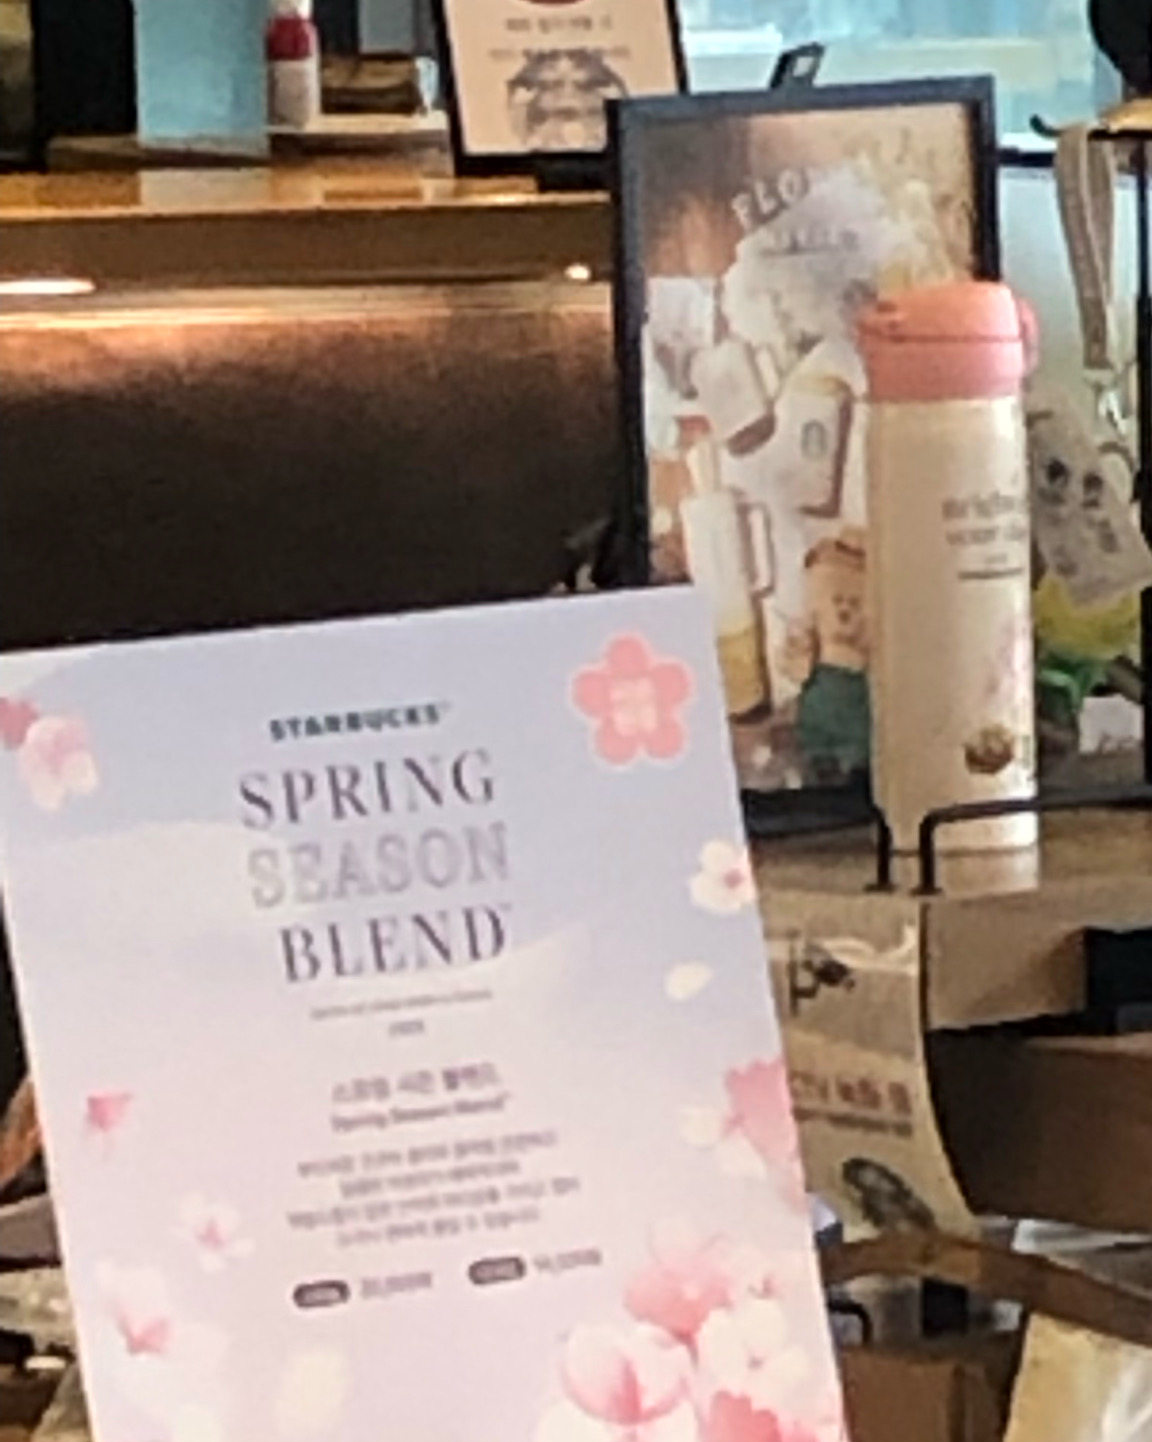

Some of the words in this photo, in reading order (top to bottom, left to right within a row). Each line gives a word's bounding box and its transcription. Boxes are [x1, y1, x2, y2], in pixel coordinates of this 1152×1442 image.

[269, 704, 441, 741] STARBUCKS
[238, 748, 494, 831] SPRING
[248, 821, 509, 909] SEASON
[280, 903, 506, 983] BLEND
